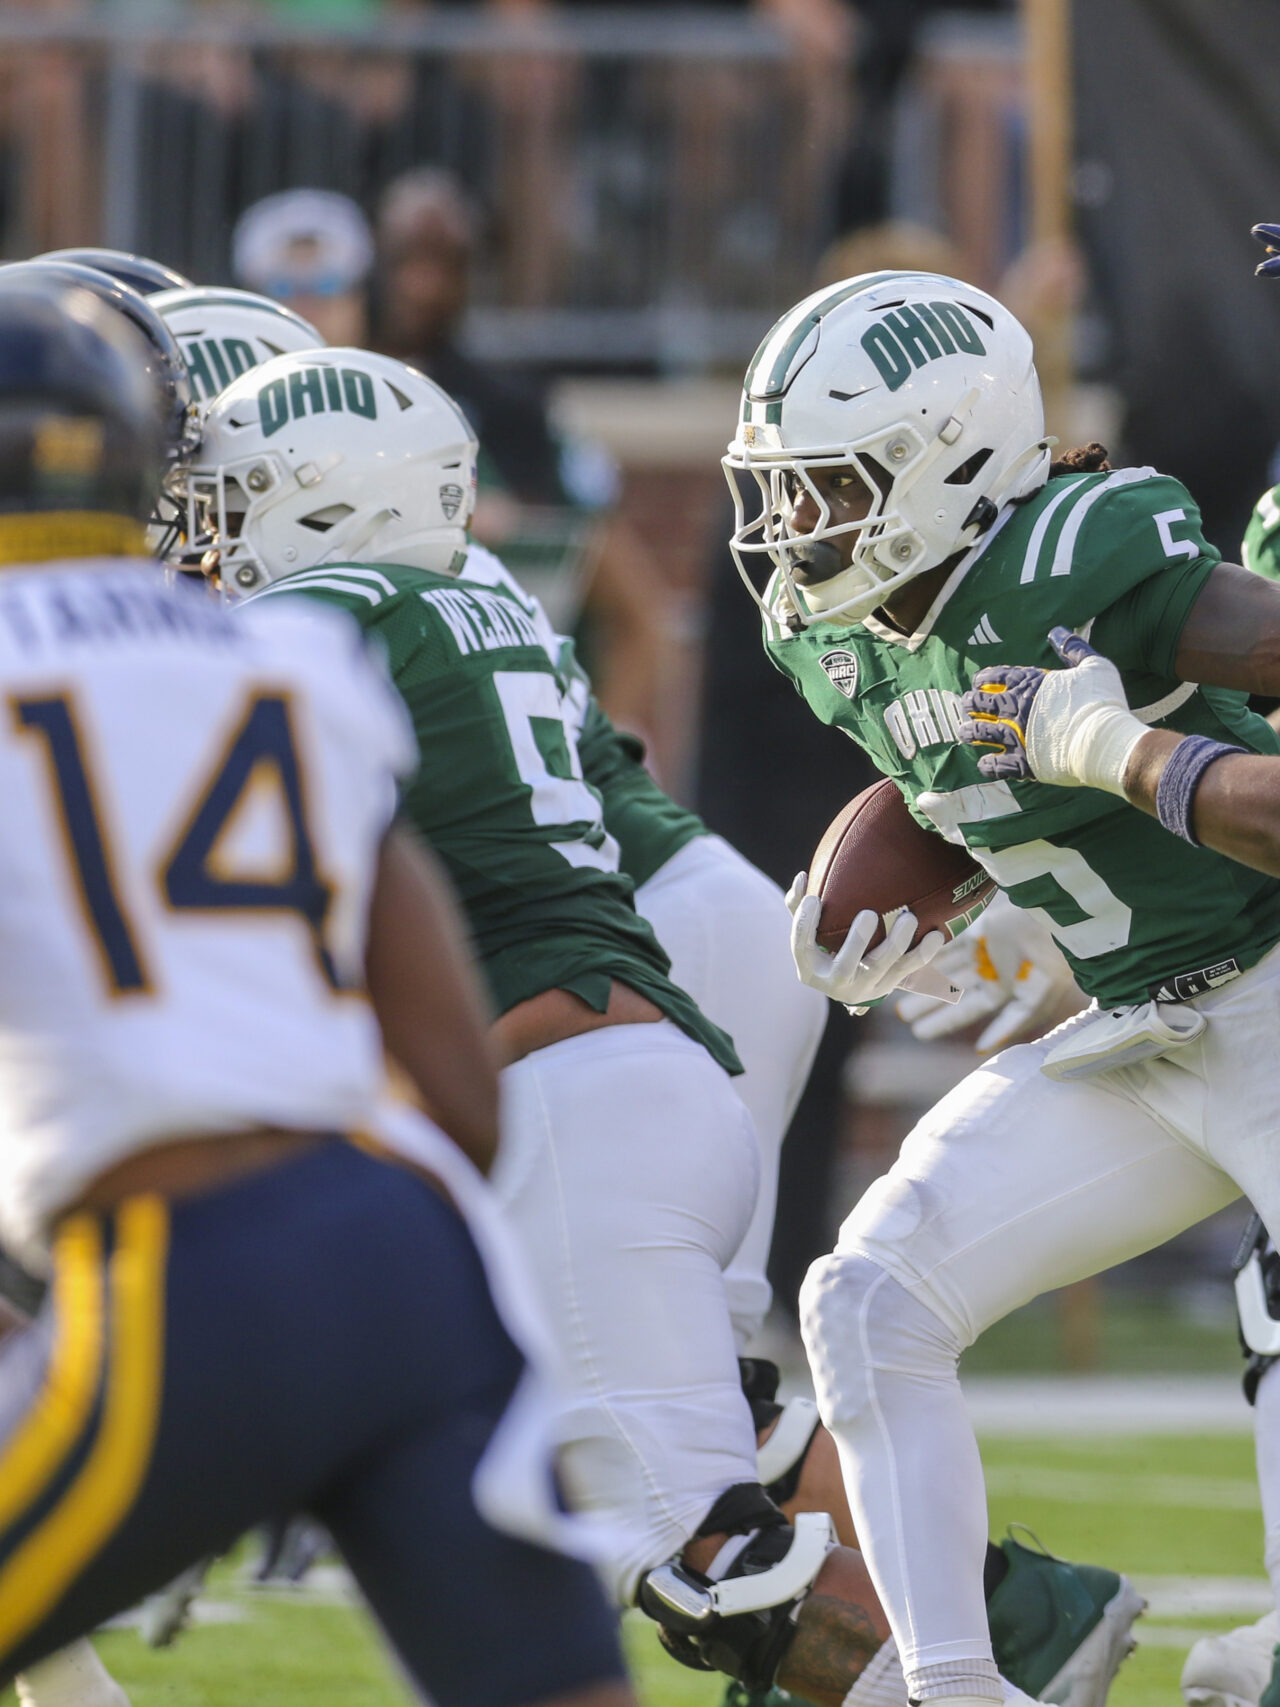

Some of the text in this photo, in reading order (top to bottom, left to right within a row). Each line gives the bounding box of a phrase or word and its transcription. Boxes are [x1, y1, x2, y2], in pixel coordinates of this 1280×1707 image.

[182, 338, 258, 402] HIO
[861, 301, 987, 392] OHIO
[258, 367, 377, 438] OHIO
[1152, 508, 1199, 560] 5
[8, 682, 366, 998] 14
[917, 779, 1132, 960] 5
